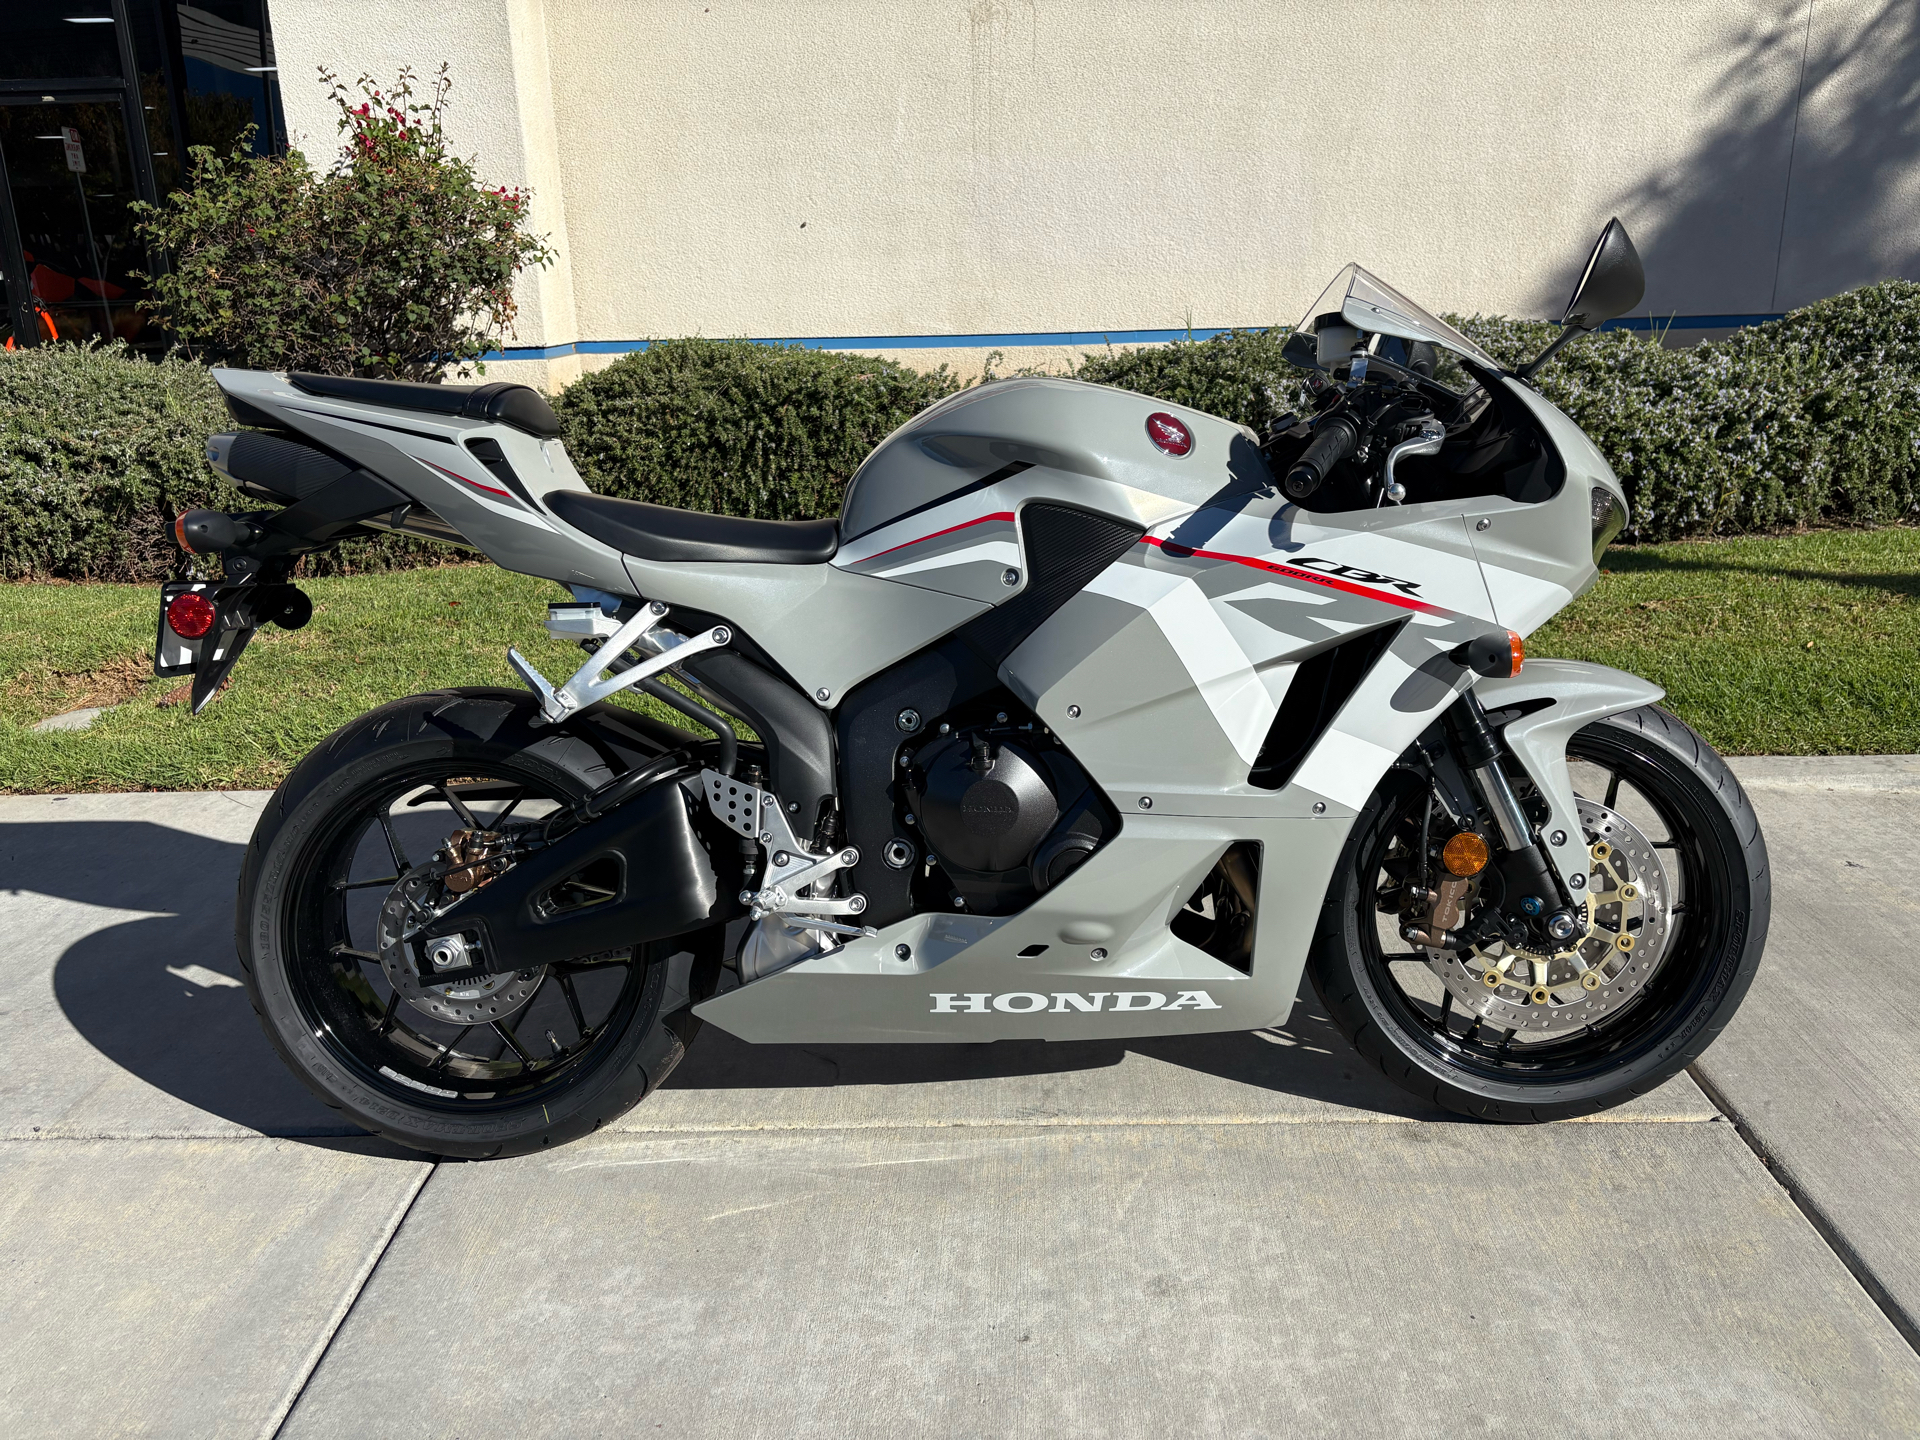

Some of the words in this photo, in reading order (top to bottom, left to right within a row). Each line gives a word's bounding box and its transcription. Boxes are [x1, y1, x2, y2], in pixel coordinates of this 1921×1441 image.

[1266, 565, 1335, 586] 600RR
[1286, 557, 1424, 598] CBR
[929, 990, 1223, 1013] HONDA
